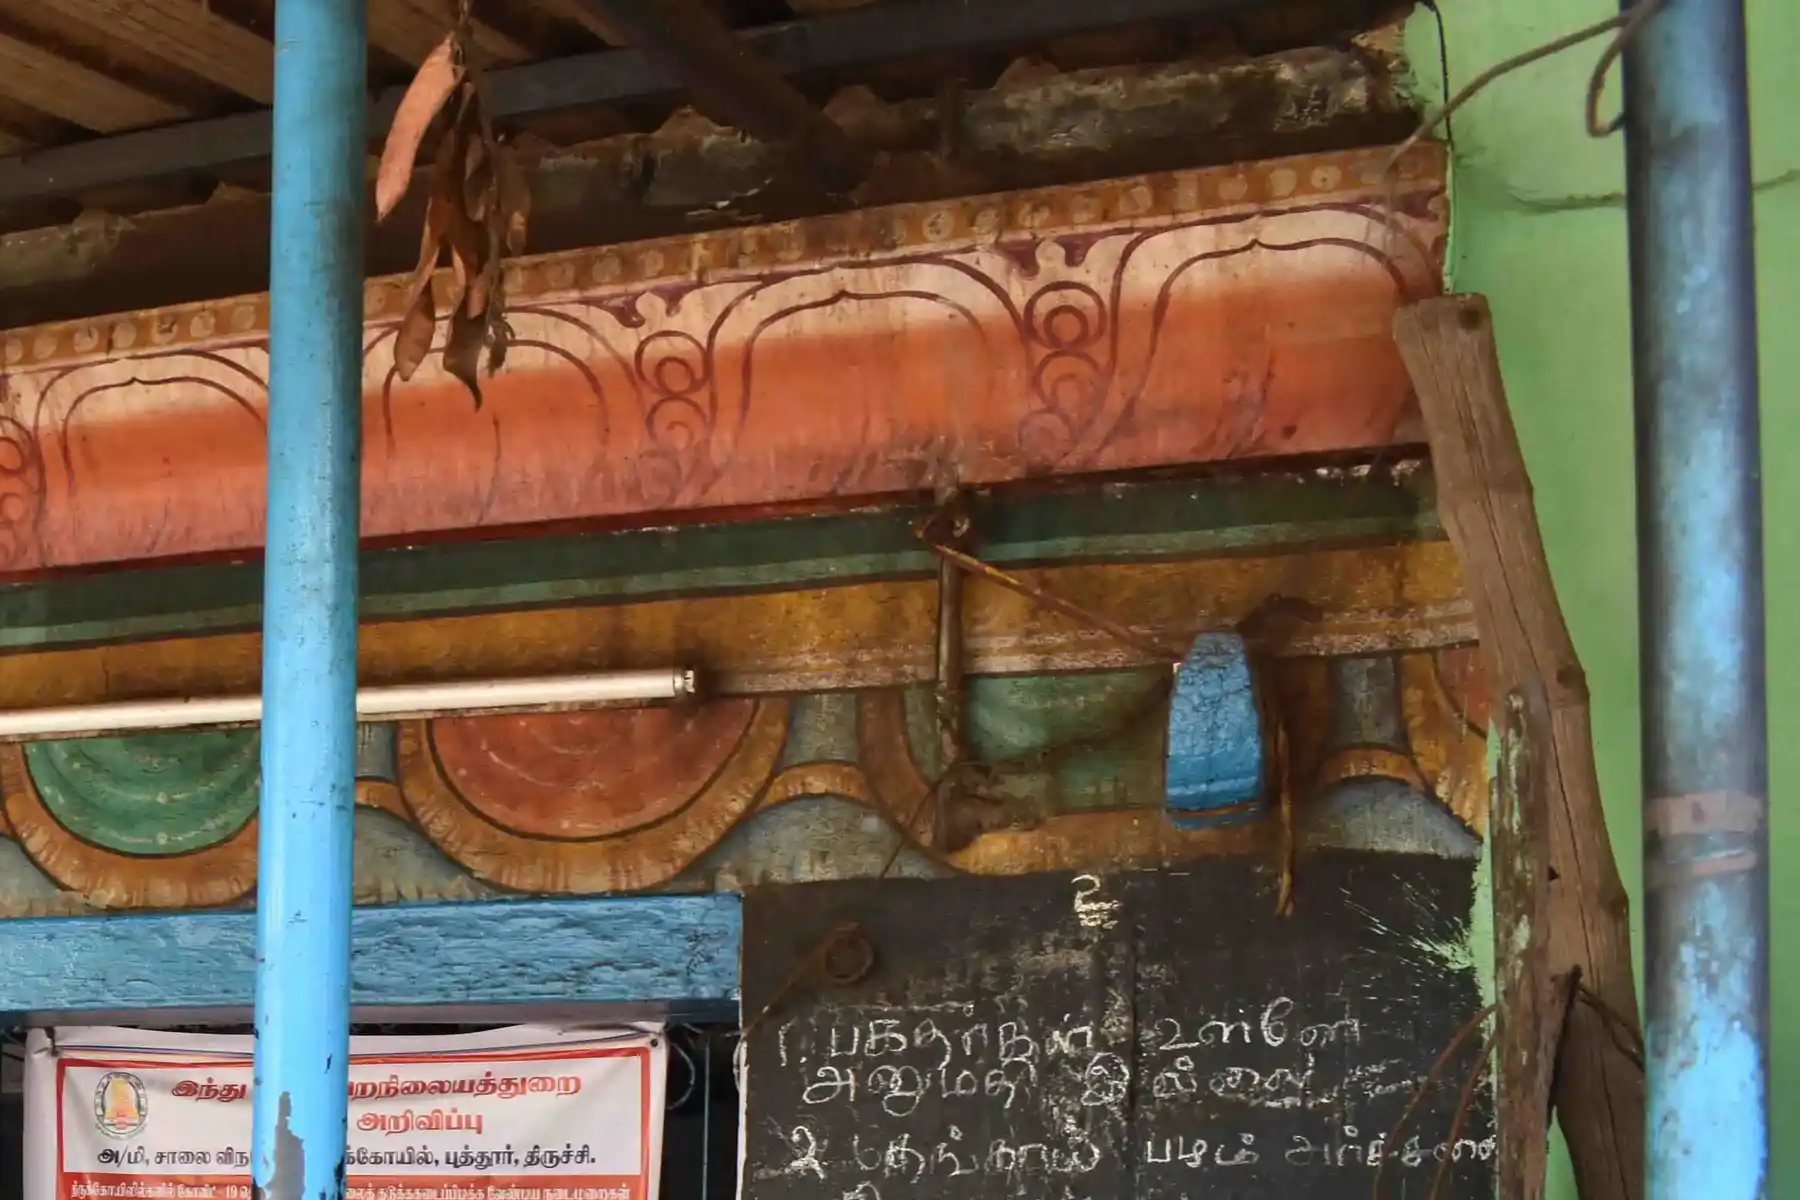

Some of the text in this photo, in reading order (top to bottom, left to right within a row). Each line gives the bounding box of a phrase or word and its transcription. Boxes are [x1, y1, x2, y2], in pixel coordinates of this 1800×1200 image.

[172, 1071, 582, 1102] இந்து றநிலையத்துறை
[357, 1107, 483, 1136] அறிவிப்பு
[155, 1151, 211, 1165] சாலை
[217, 1147, 249, 1169] விந
[445, 1144, 519, 1170] புத்தூர்,
[524, 1144, 596, 1169] திருச்சி.
